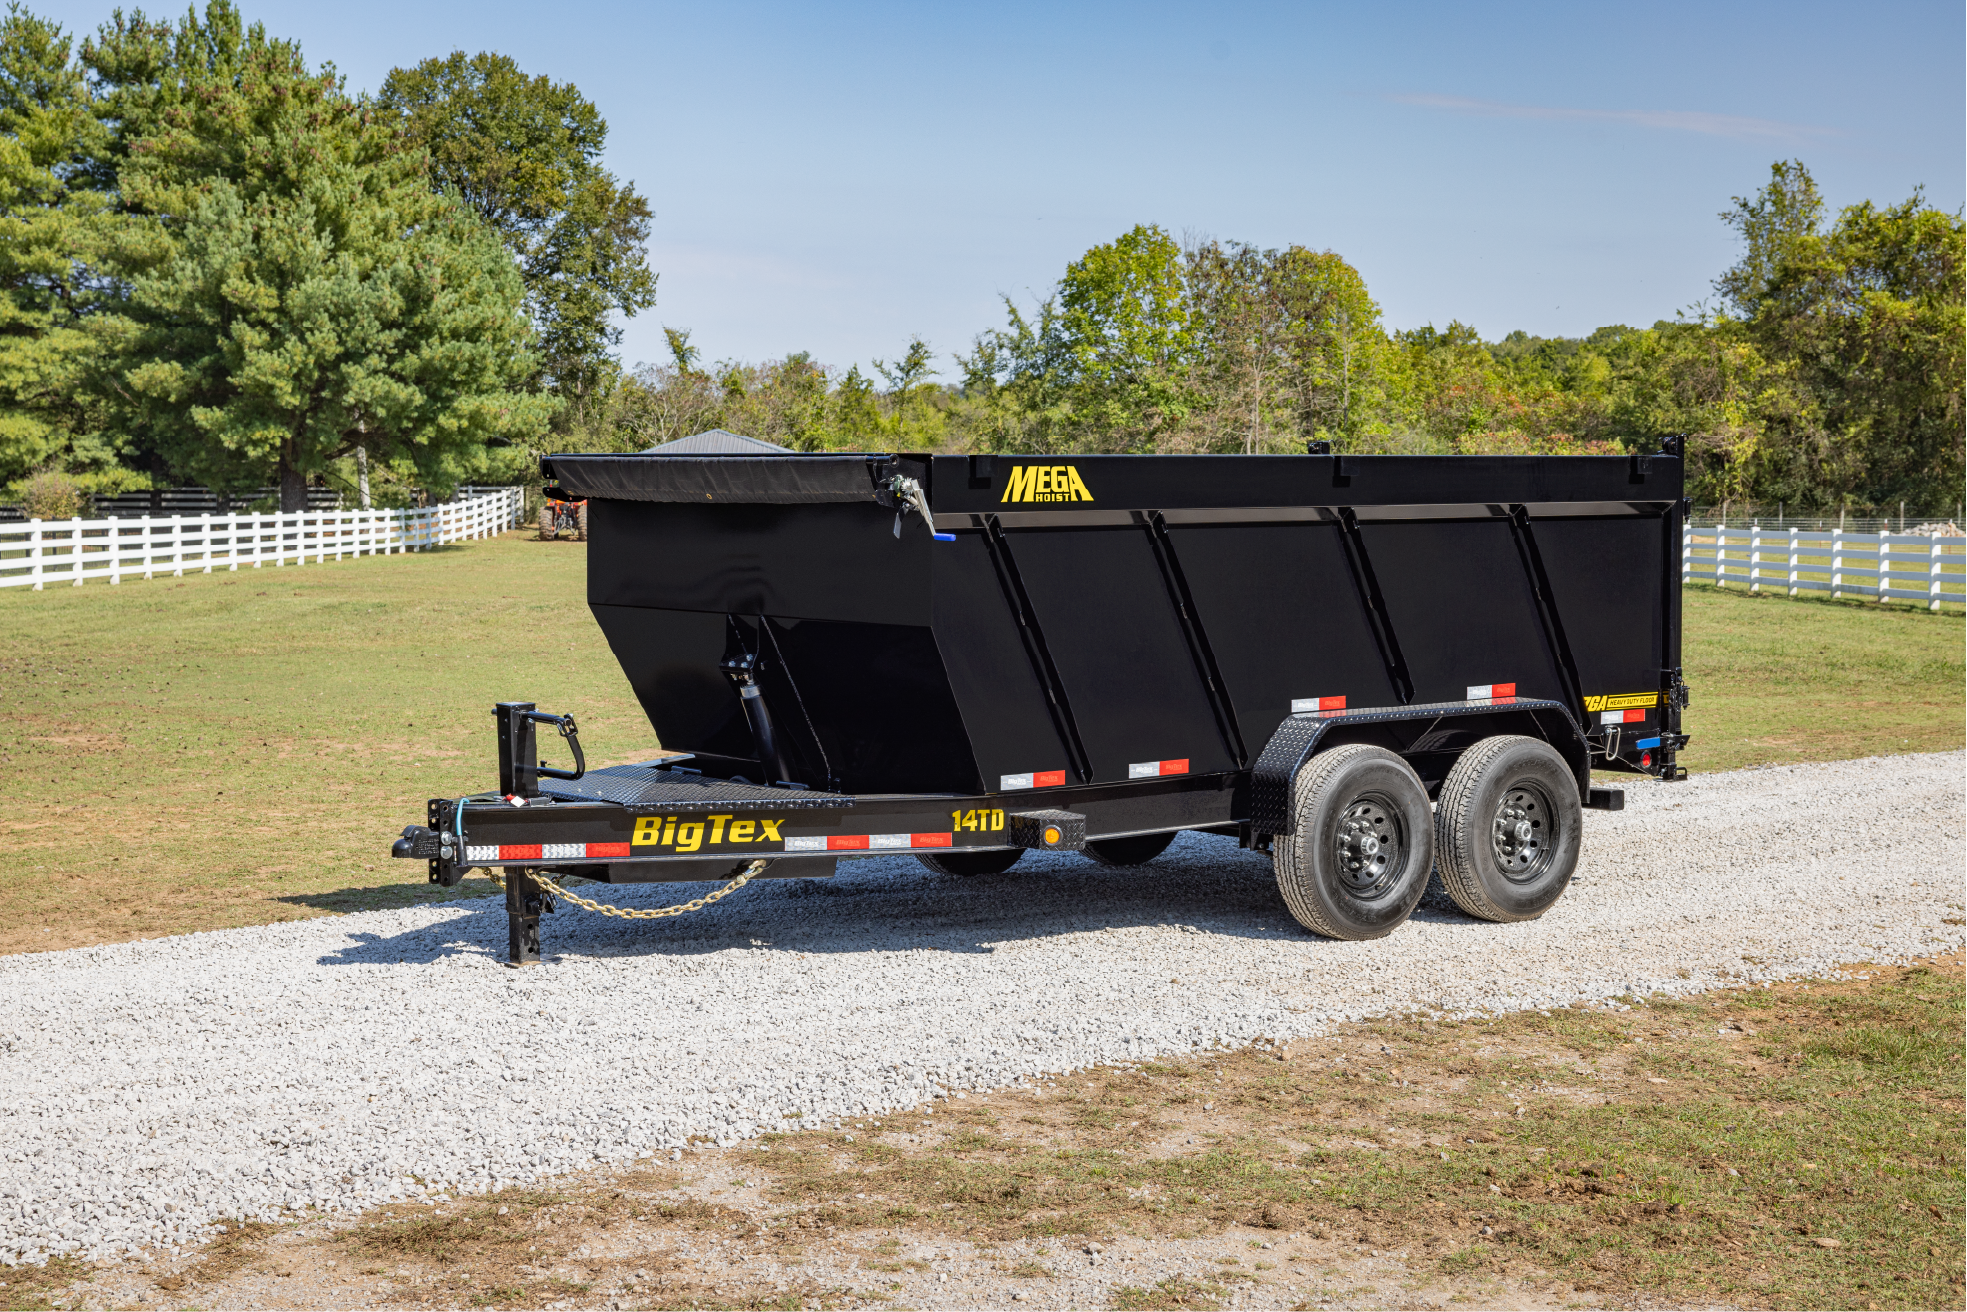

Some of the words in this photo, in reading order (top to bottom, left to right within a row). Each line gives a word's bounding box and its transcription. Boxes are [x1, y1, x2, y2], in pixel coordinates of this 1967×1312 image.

[1000, 465, 1094, 502] MEGA
[1035, 493, 1070, 502] HOIST
[1583, 695, 1608, 711] GA
[952, 809, 1004, 831] 14TD
[631, 815, 785, 852] BigTex
